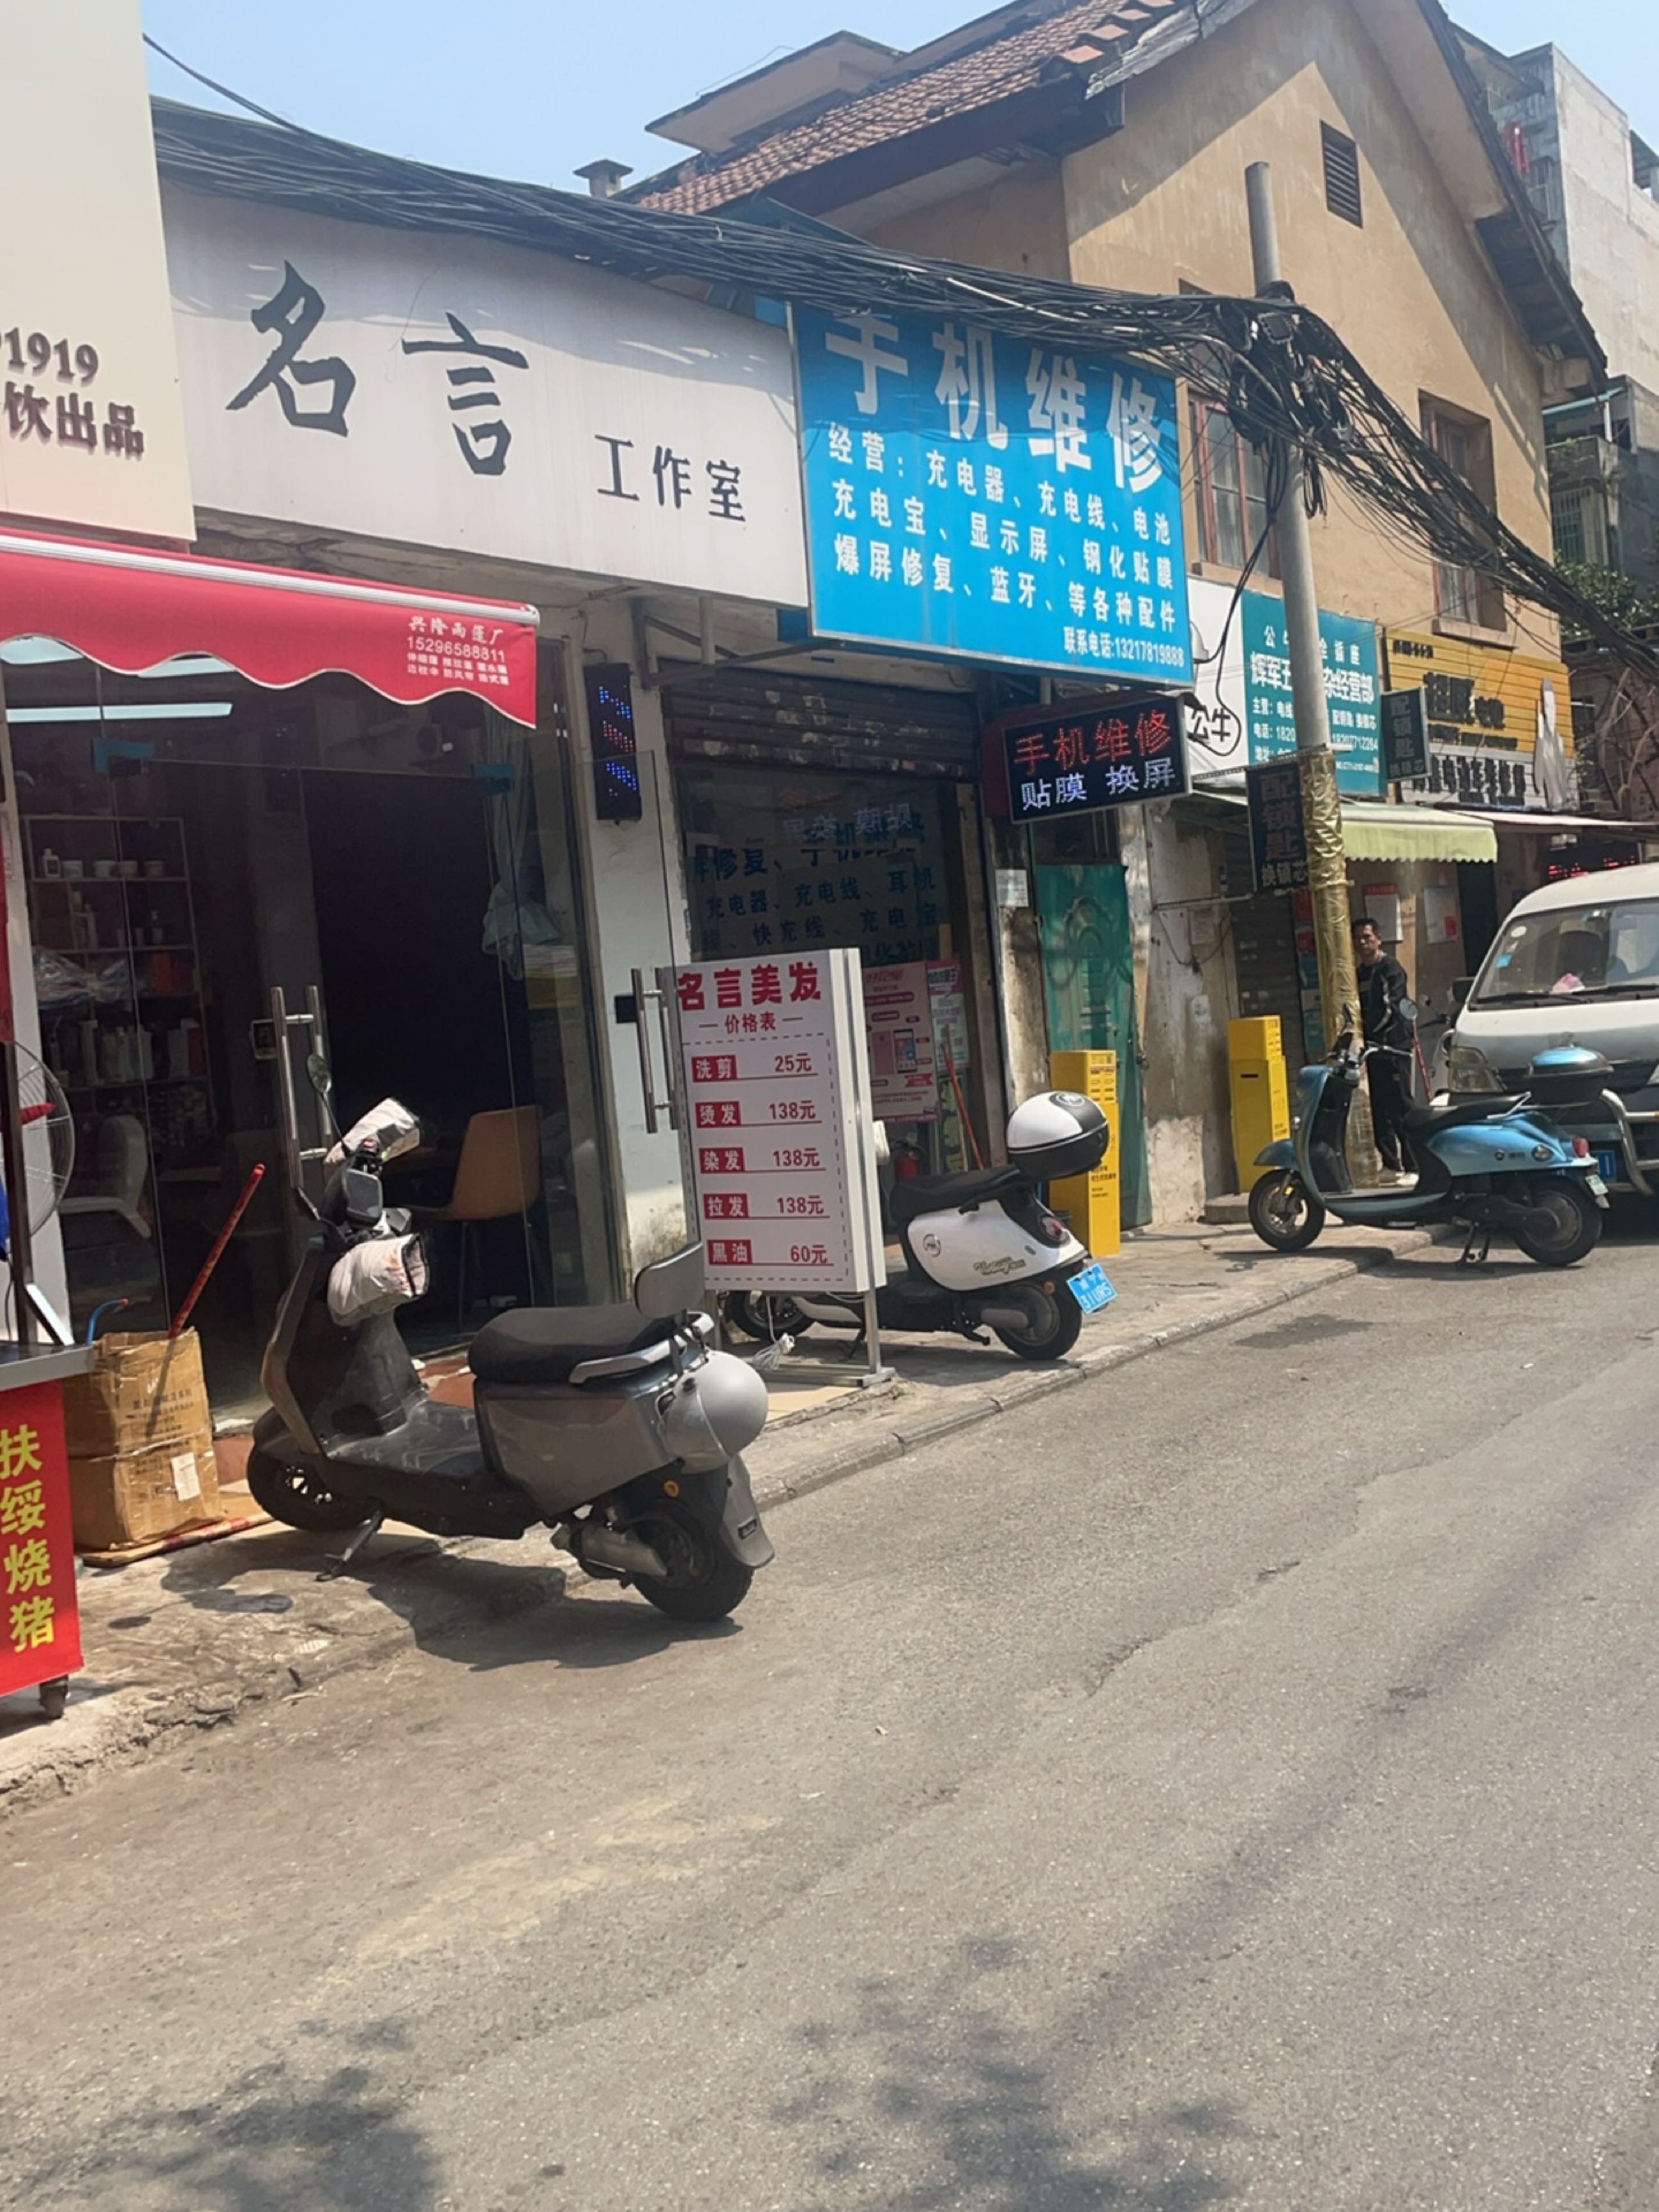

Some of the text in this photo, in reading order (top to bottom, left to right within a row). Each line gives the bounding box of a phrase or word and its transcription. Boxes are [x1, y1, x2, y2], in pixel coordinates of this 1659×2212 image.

[226, 260, 746, 522] 名言 工作室
[825, 312, 1164, 493] 手机维修
[832, 478, 1173, 590] 充电宝、显示屏、钢化贴膜
[834, 533, 1176, 633] 爆屏修复、蓝牙、等各种配件
[406, 636, 506, 663] 15296588811
[1014, 710, 1171, 775] 手机维修
[1192, 705, 1231, 742] 公牛
[1021, 757, 1176, 810] 贴膜 换屏
[678, 961, 821, 1011] 名言美发
[724, 1013, 777, 1034] 价格表
[696, 1054, 812, 1080] 洗剪 25元
[700, 1100, 816, 1126] 烫发 138元
[704, 1148, 820, 1171] 染发 138元
[708, 1195, 824, 1217] 拉发 138元
[712, 1242, 828, 1264] 黑油 60元
[0, 1424, 55, 1653] 扶绥烧猪
